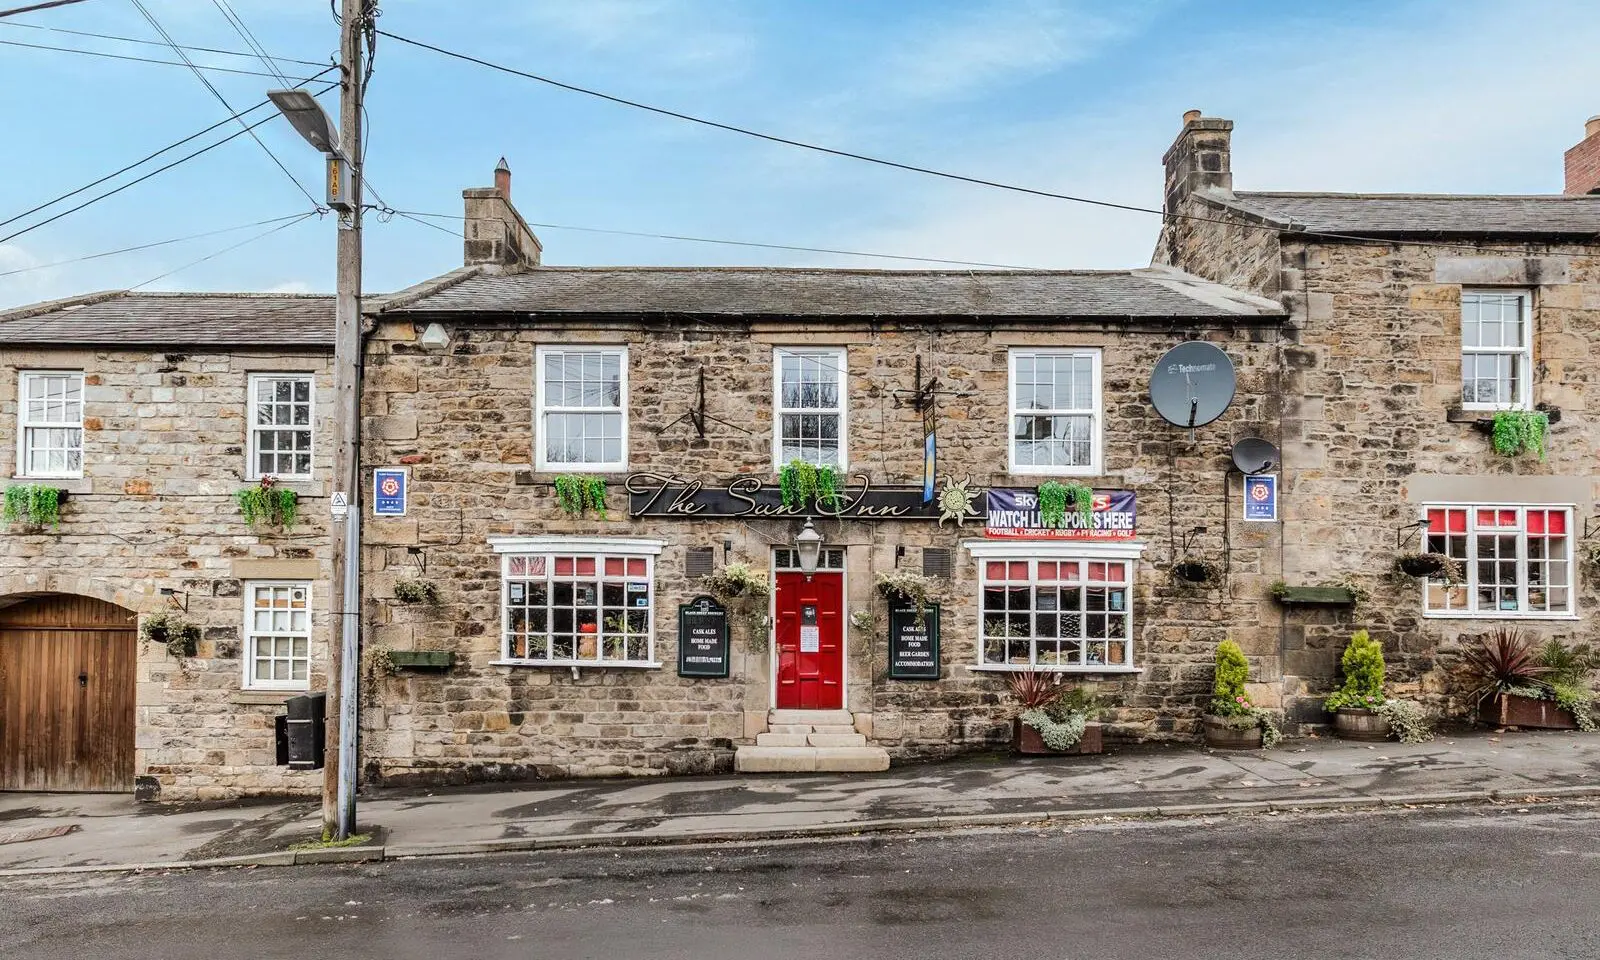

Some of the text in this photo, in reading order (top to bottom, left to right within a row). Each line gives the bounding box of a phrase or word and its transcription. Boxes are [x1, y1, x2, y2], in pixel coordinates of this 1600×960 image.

[624, 472, 911, 517] The Sun Inn
[1015, 494, 1038, 509] sky
[989, 510, 1029, 528] WATCH
[1058, 511, 1104, 529] SPORS
[1104, 511, 1133, 529] HERE
[1024, 528, 1051, 536] CRICKET
[1089, 529, 1113, 537] RACING
